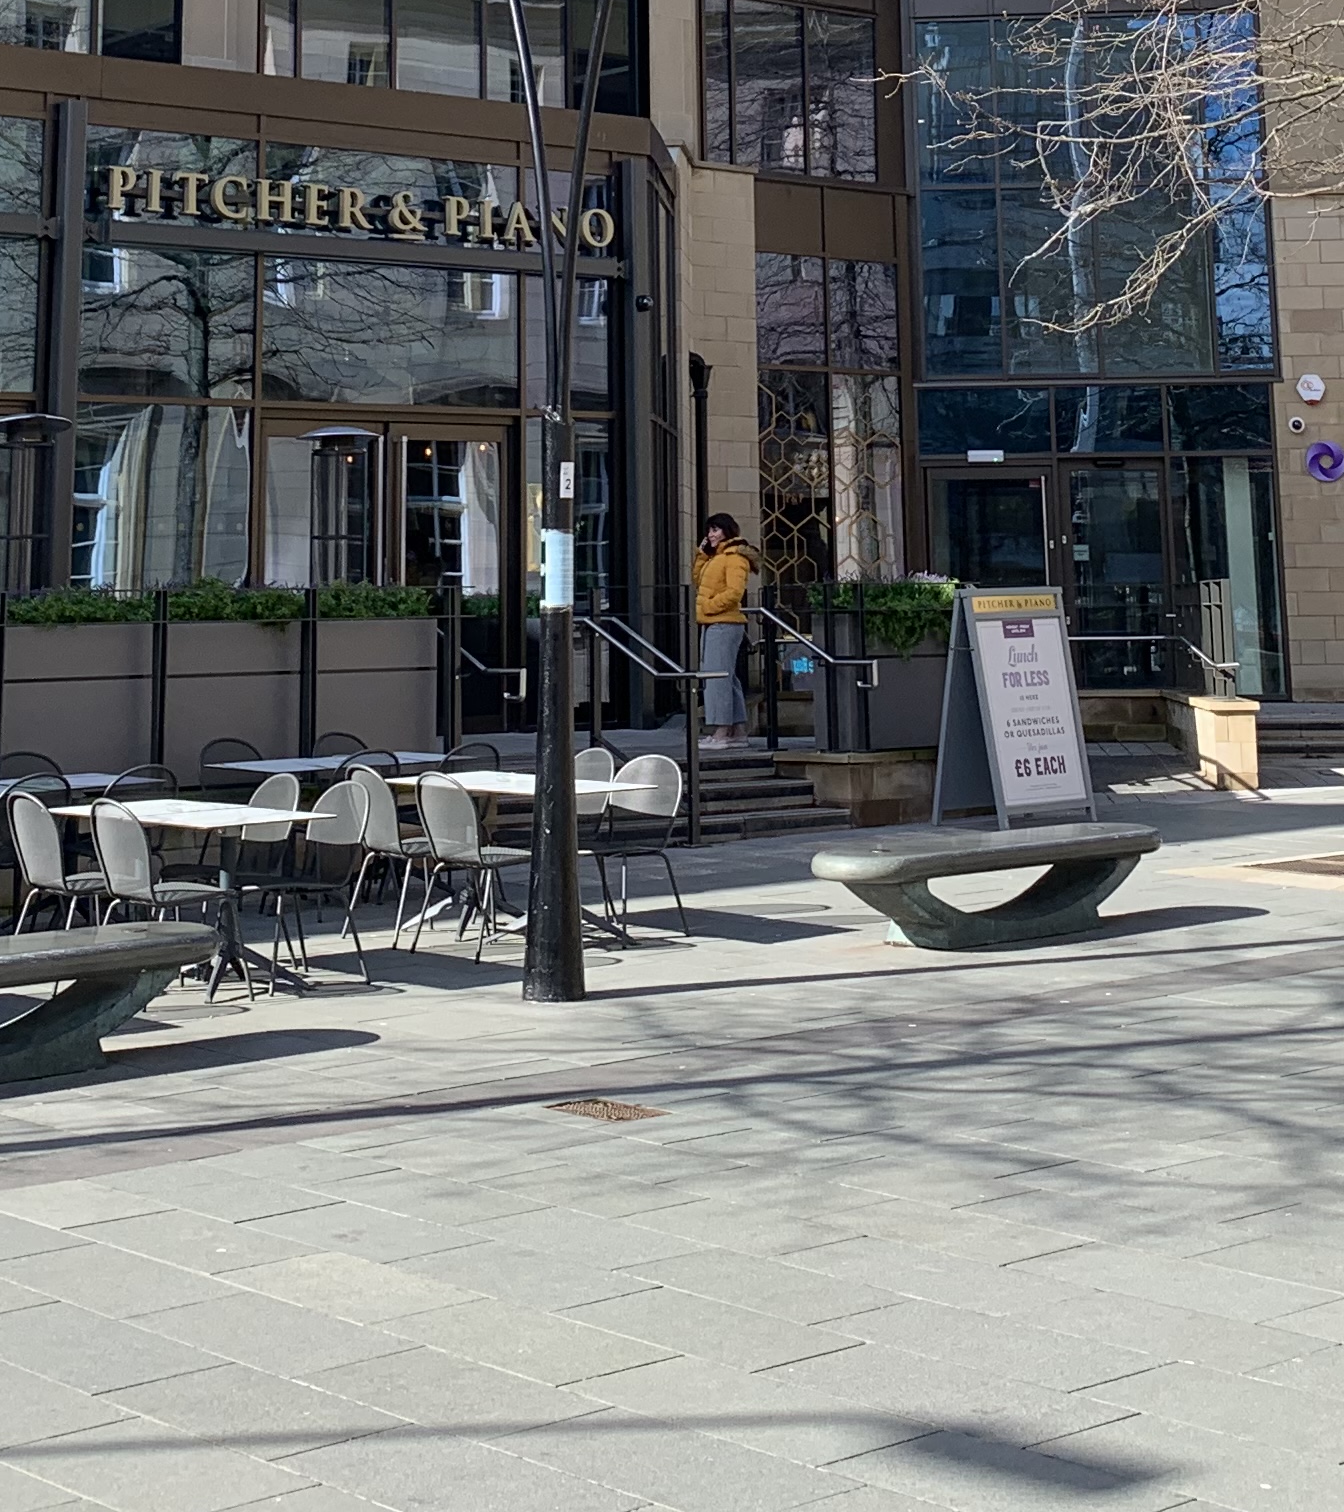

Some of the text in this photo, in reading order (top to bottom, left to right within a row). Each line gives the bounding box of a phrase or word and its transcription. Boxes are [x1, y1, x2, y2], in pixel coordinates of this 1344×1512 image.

[106, 165, 372, 231] PITCHER
[387, 191, 427, 241] &
[565, 478, 571, 490] 2
[977, 598, 1014, 609] PITCHER
[1024, 598, 1052, 608] PIANO
[1008, 644, 1038, 667] Lunch
[1002, 670, 1050, 688] FOR LESS
[1012, 716, 1060, 727] SANDWICHES
[1004, 726, 1065, 738] OR QUESADILLAS
[1014, 755, 1067, 778] £6 EACH
